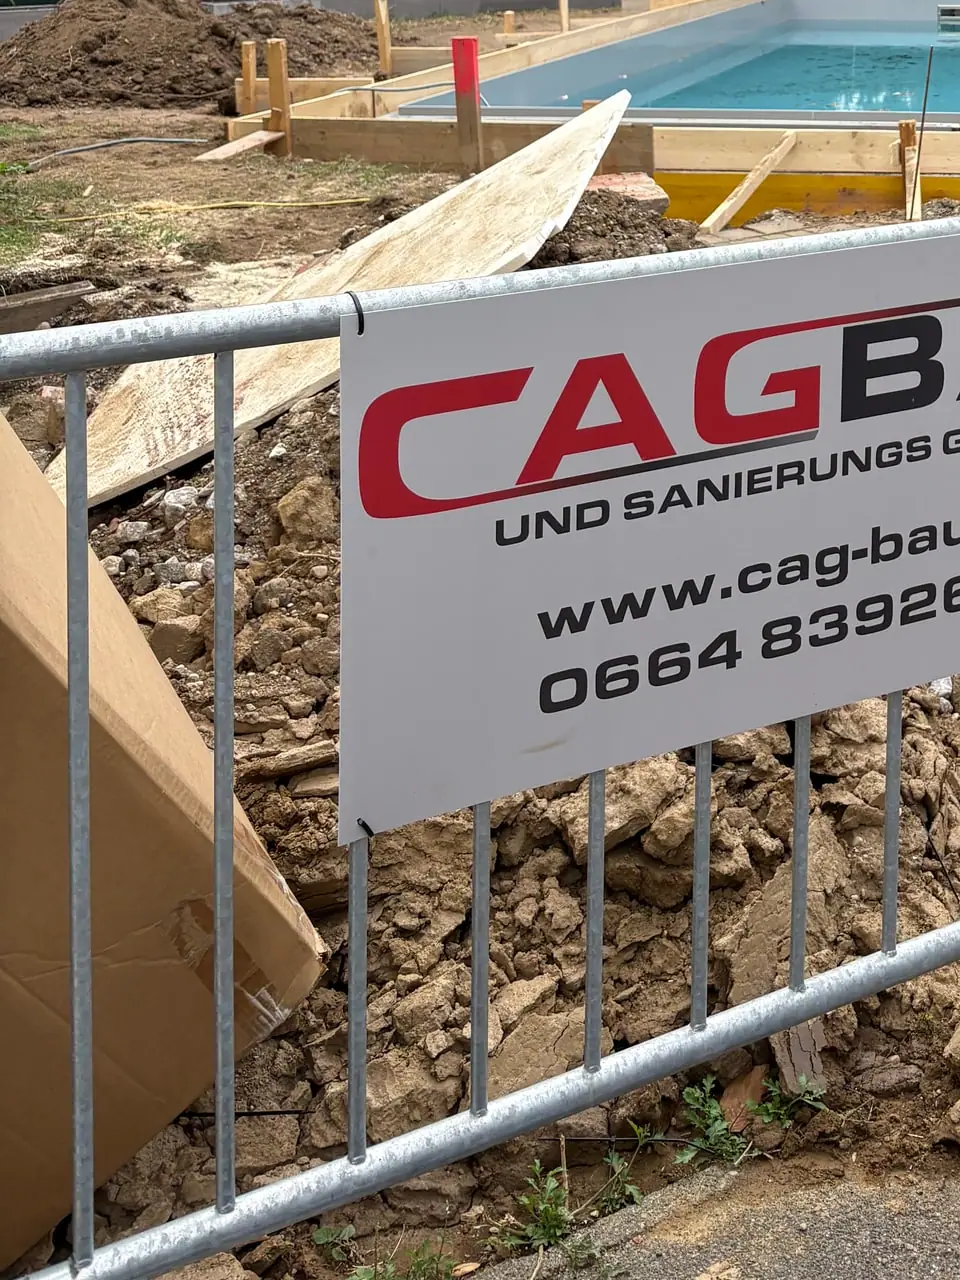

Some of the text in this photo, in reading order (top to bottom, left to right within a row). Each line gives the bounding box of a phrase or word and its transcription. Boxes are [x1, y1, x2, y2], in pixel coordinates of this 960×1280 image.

[495, 499, 611, 547] UND
[623, 435, 932, 521] SANIERUNGS
[539, 629, 743, 714] 0664
